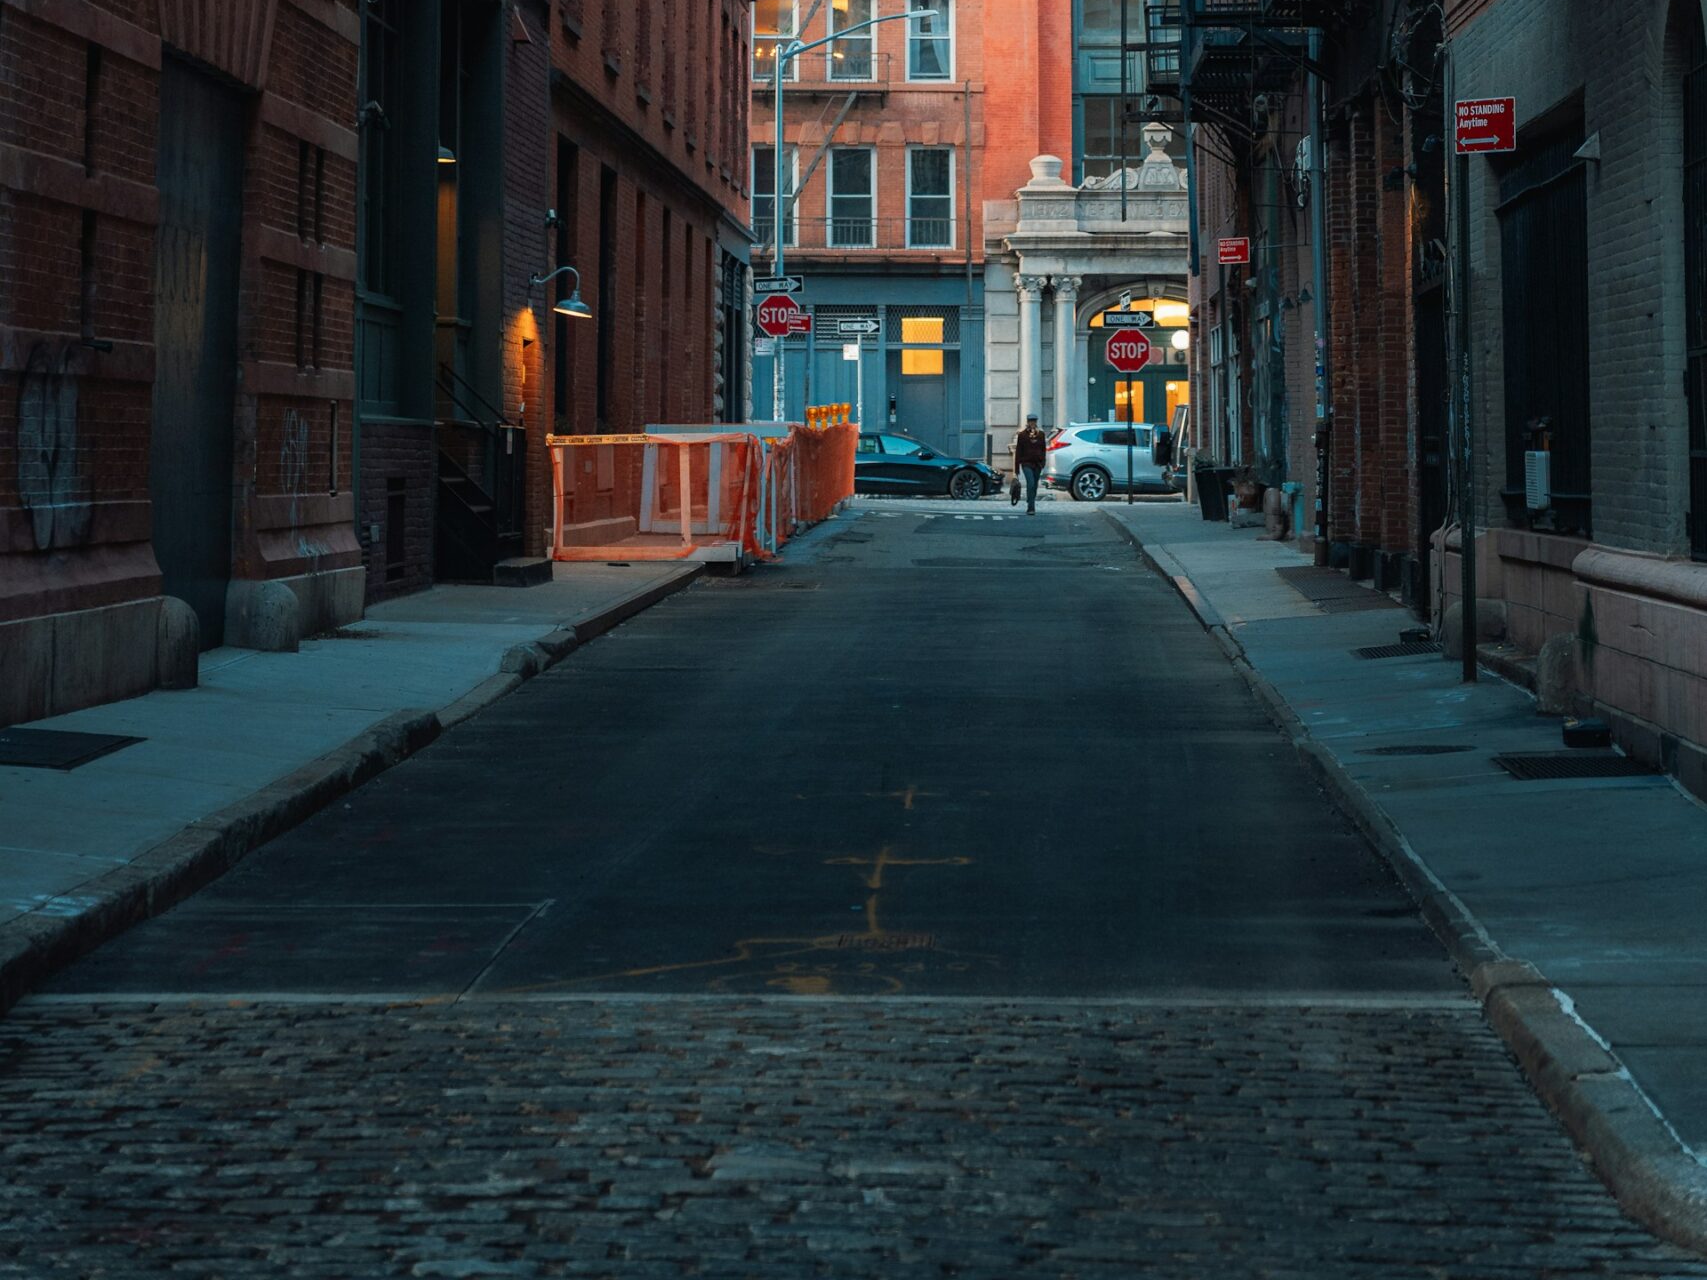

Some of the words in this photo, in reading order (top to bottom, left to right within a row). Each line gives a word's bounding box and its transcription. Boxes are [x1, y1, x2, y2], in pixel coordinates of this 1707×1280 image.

[1458, 106, 1469, 116] NO
[1470, 104, 1505, 115] STANDING
[1460, 117, 1488, 130] Anytime
[1077, 202, 1164, 217] MERCNTILE
[758, 282, 771, 290] ONE
[779, 281, 793, 289] WAY
[1110, 342, 1147, 359] STOP
